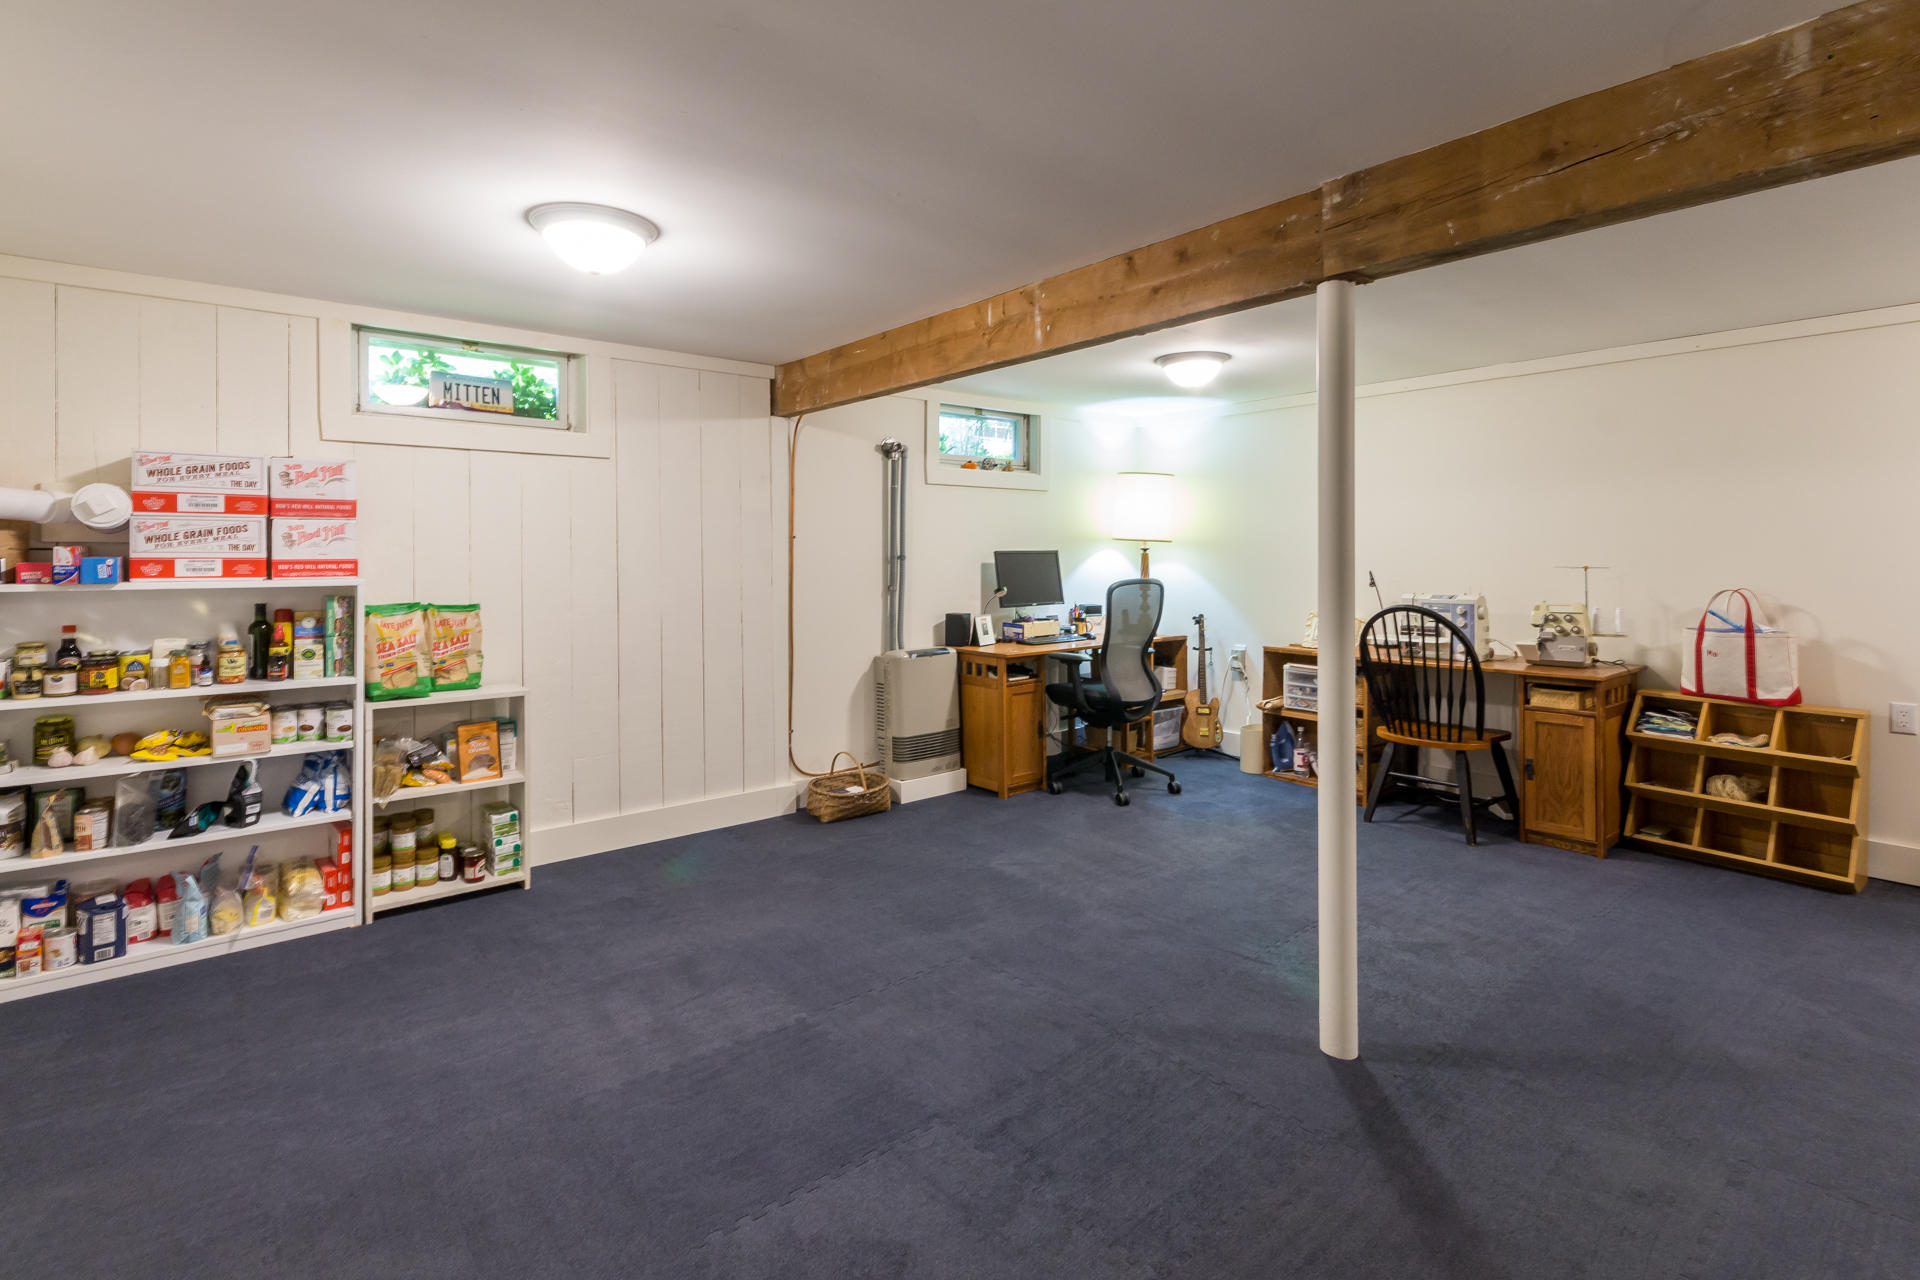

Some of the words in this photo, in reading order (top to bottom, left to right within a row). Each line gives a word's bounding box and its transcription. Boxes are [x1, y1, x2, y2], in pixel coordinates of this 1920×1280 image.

[443, 381, 500, 405] MITTEN
[146, 466, 182, 478] WHOLE
[185, 464, 216, 475] GRAIN
[218, 461, 251, 471] FOODS
[230, 480, 243, 488] THE
[244, 480, 258, 488] DAY
[144, 532, 180, 544] WHOLE
[183, 529, 213, 540] GRAIN
[216, 524, 249, 535] FOODS
[228, 543, 240, 551] THE
[242, 543, 256, 552] DAY
[376, 642, 394, 654] SEA
[397, 632, 417, 648] SALT
[432, 640, 449, 652] SEA
[450, 632, 470, 647] SALT
